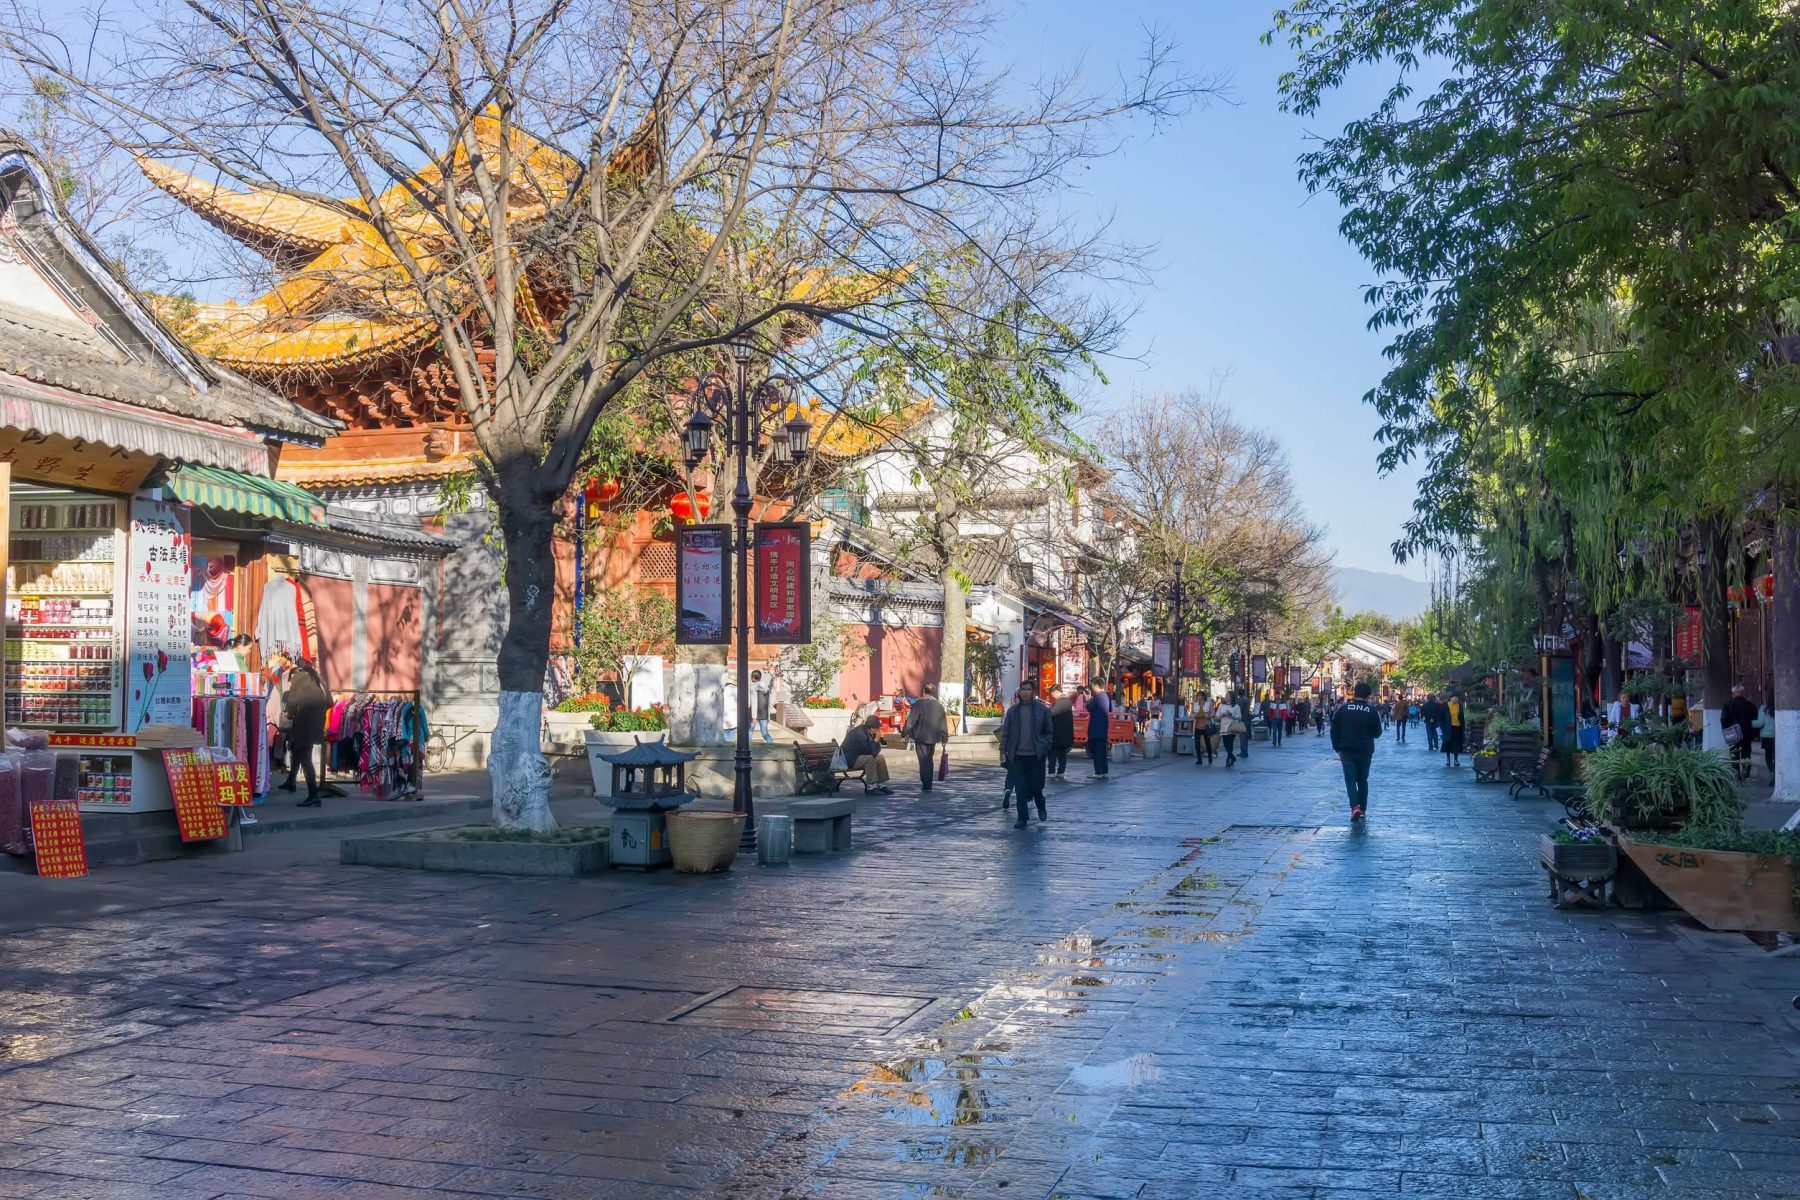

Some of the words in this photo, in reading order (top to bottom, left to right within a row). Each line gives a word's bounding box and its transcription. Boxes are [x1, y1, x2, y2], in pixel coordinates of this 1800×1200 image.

[1347, 704, 1370, 713] DNA
[217, 764, 248, 783] 批发
[219, 784, 249, 804] 玛卡
